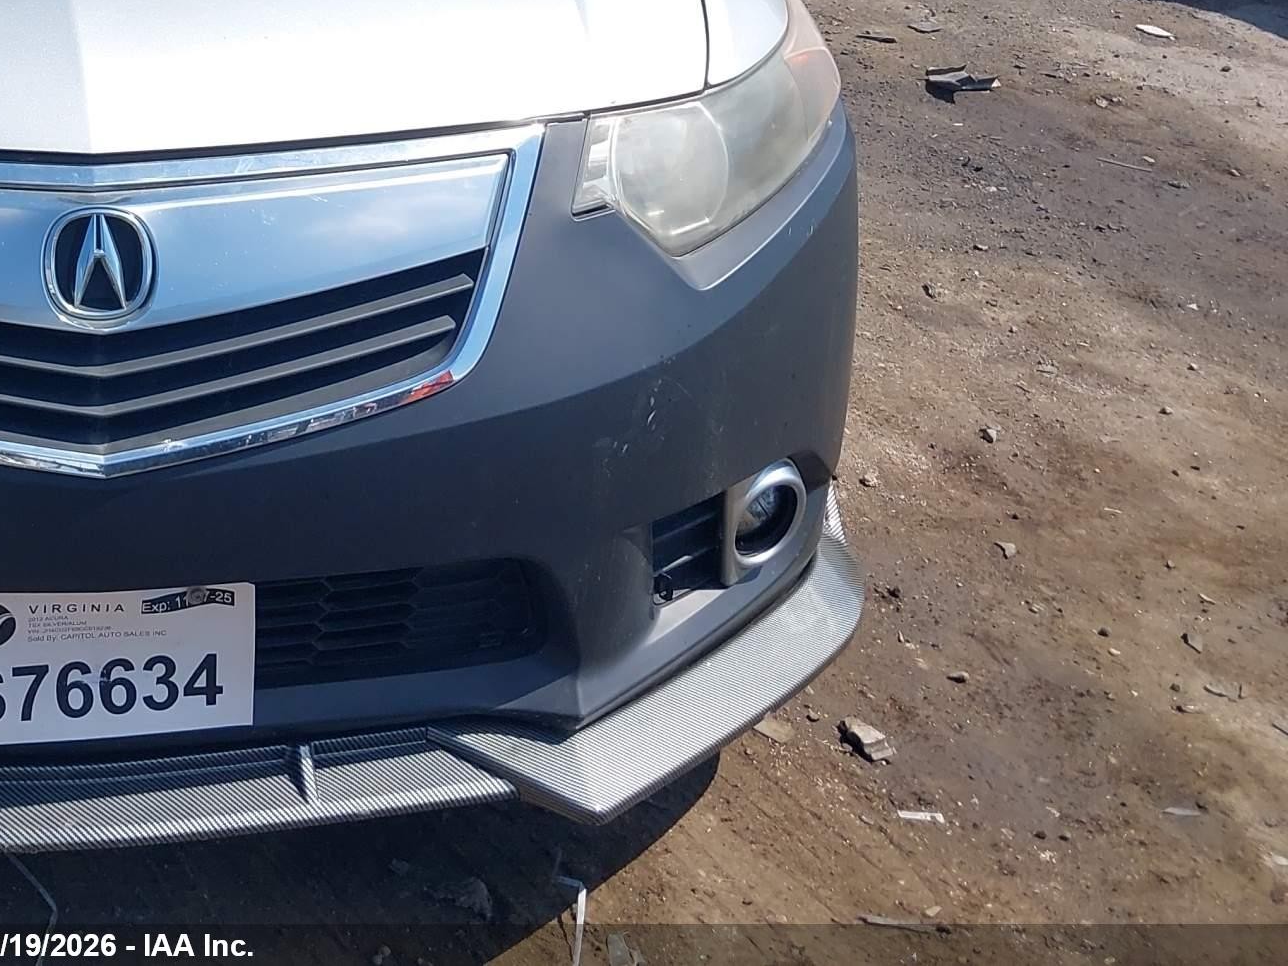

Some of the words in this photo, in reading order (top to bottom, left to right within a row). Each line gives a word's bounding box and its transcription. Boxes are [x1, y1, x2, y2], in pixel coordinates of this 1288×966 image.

[28, 603, 125, 614] VIRGINIA
[142, 601, 171, 613] Exp:
[61, 633, 96, 641] CAPITOL
